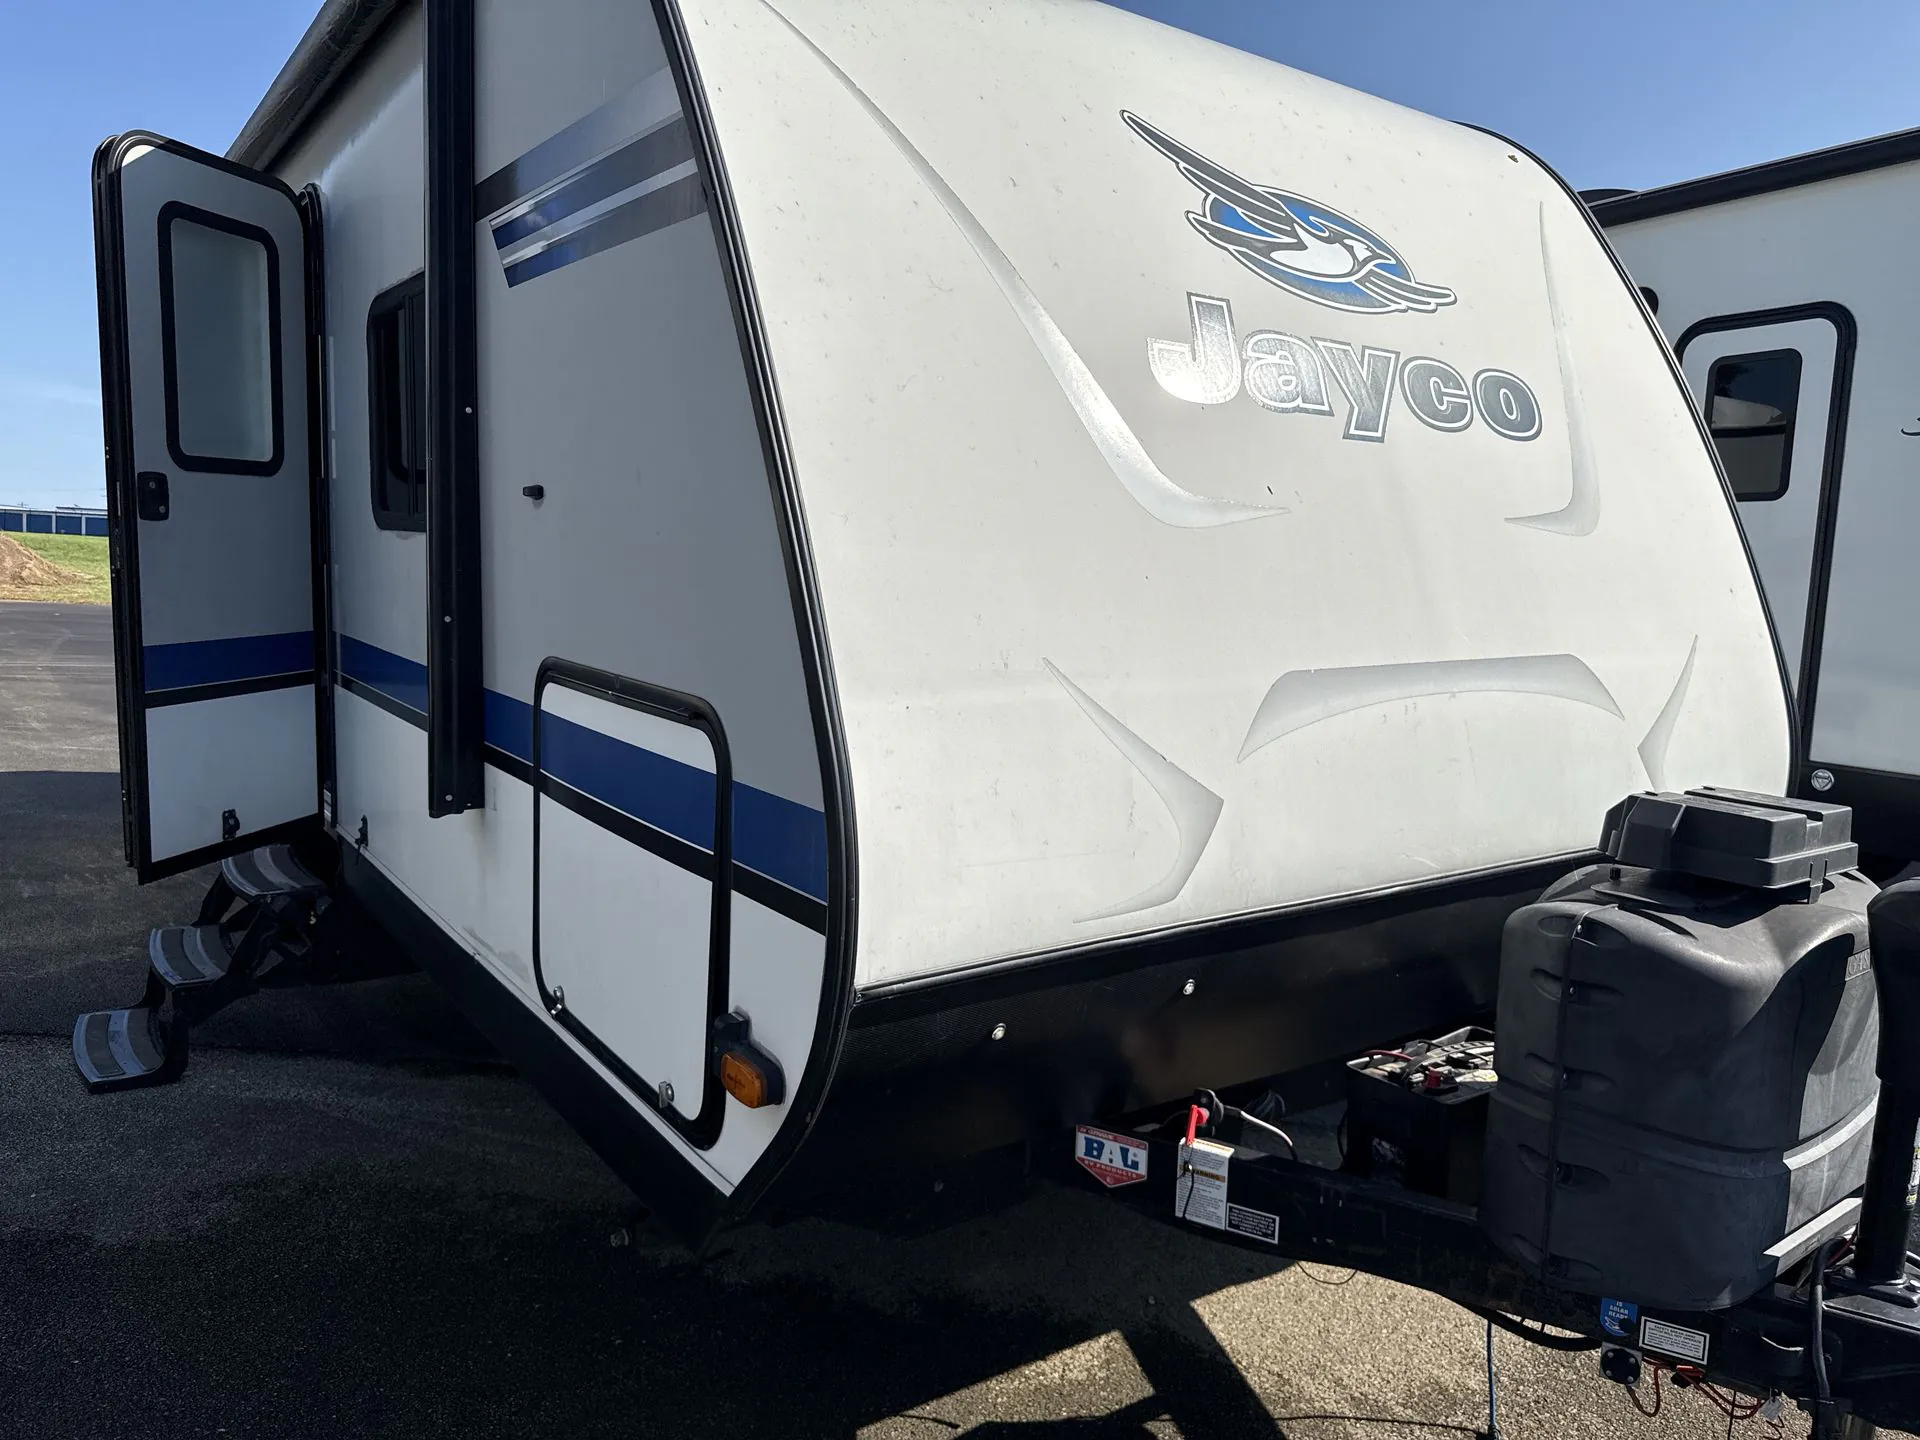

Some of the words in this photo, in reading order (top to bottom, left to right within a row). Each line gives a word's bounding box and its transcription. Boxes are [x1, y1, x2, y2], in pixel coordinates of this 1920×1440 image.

[1147, 291, 1542, 443] Jayco
[1084, 1136, 1139, 1171] BAL
[1096, 1163, 1137, 1178] PRODUCTS
[1609, 1305, 1629, 1315] SOLAR
